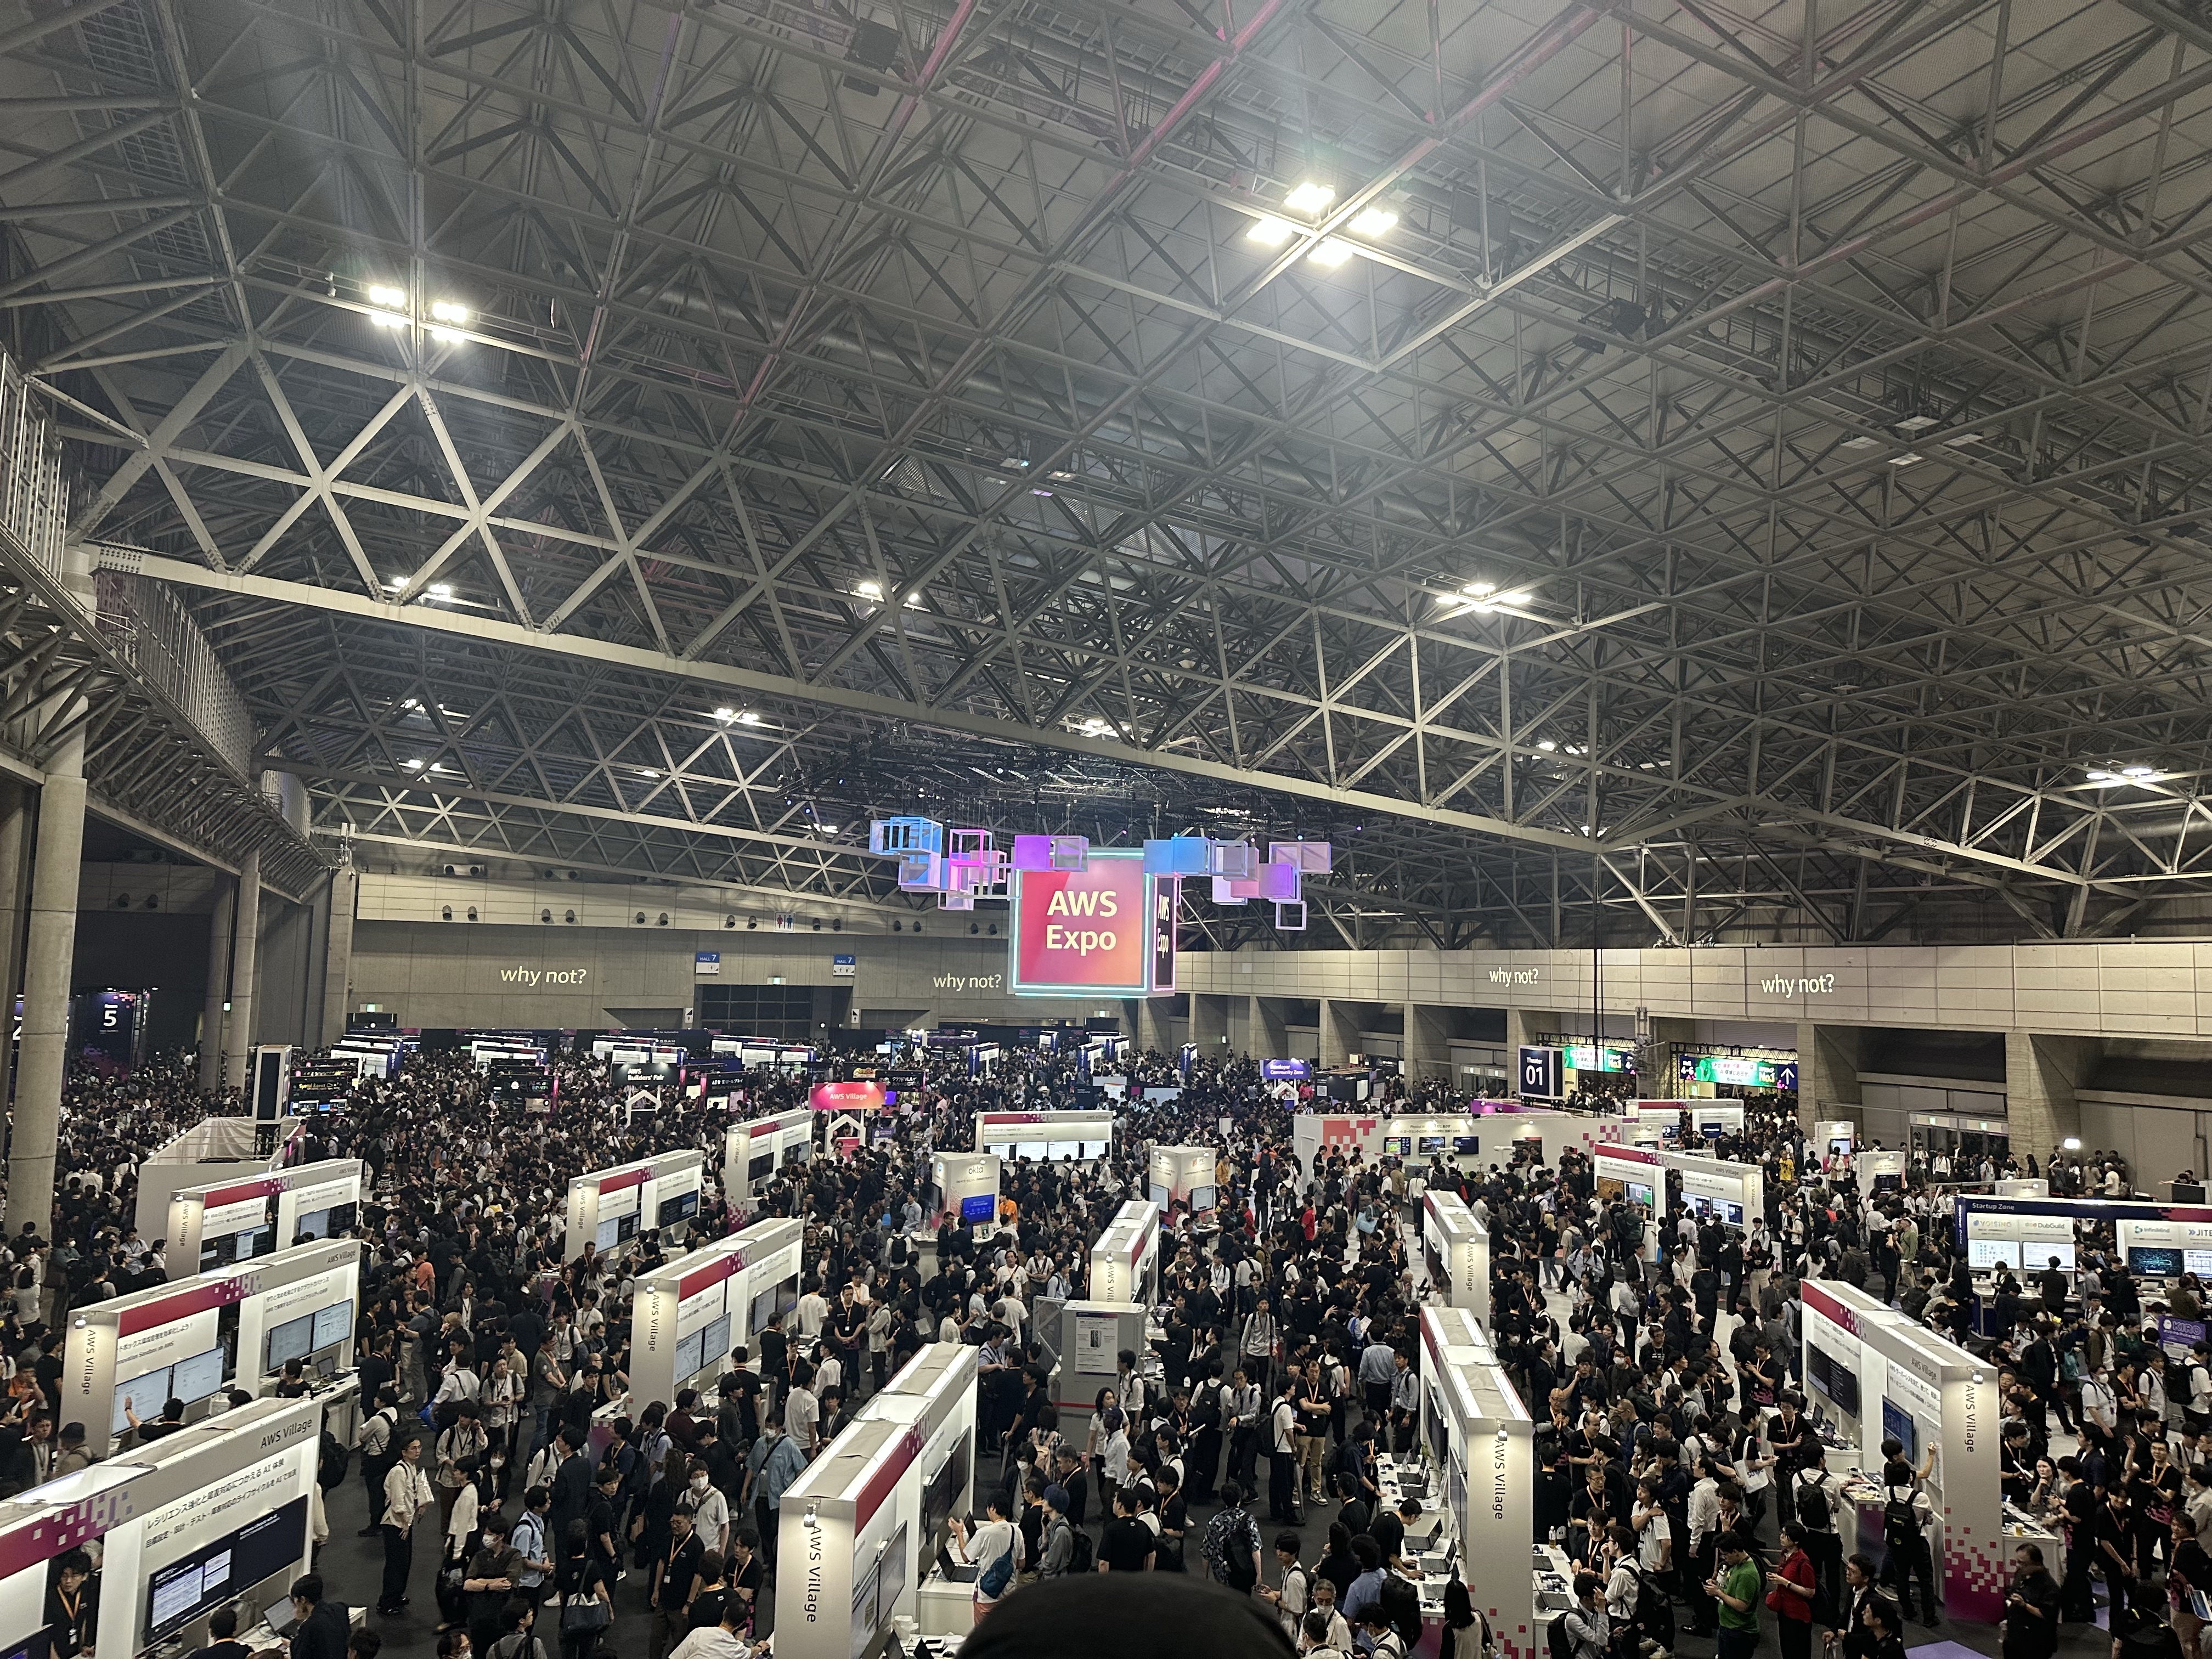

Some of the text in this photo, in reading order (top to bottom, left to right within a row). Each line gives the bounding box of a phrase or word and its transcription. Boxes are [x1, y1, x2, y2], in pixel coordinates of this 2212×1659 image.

[1047, 890, 1117, 917] AWS
[1158, 894, 1170, 921] AWS
[1046, 924, 1116, 956] Expo
[1157, 928, 1169, 958] Expo
[500, 966, 586, 986] why not?
[933, 973, 1002, 991] why not?
[1489, 968, 1538, 987] why not?
[1761, 973, 1835, 998] why not?
[103, 1010, 117, 1026] 5
[1526, 1065, 1543, 1086] 01
[1681, 1065, 1694, 1075] 4-6
[846, 1093, 867, 1101] Village
[969, 1166, 984, 1174] okta
[577, 1206, 585, 1229] Village
[179, 1221, 188, 1246] Village
[327, 1250, 356, 1264] AWS Village
[648, 1318, 658, 1351] Village
[2172, 1321, 2202, 1335] KIRO
[81, 1329, 95, 1395] AWS Village
[1911, 1357, 1937, 1381] AWS Village
[1964, 1384, 1976, 1452] AWS Village
[260, 1419, 312, 1449] AWS Village
[1492, 1440, 1505, 1519] AWS Village
[804, 1526, 822, 1622] AWS Village
